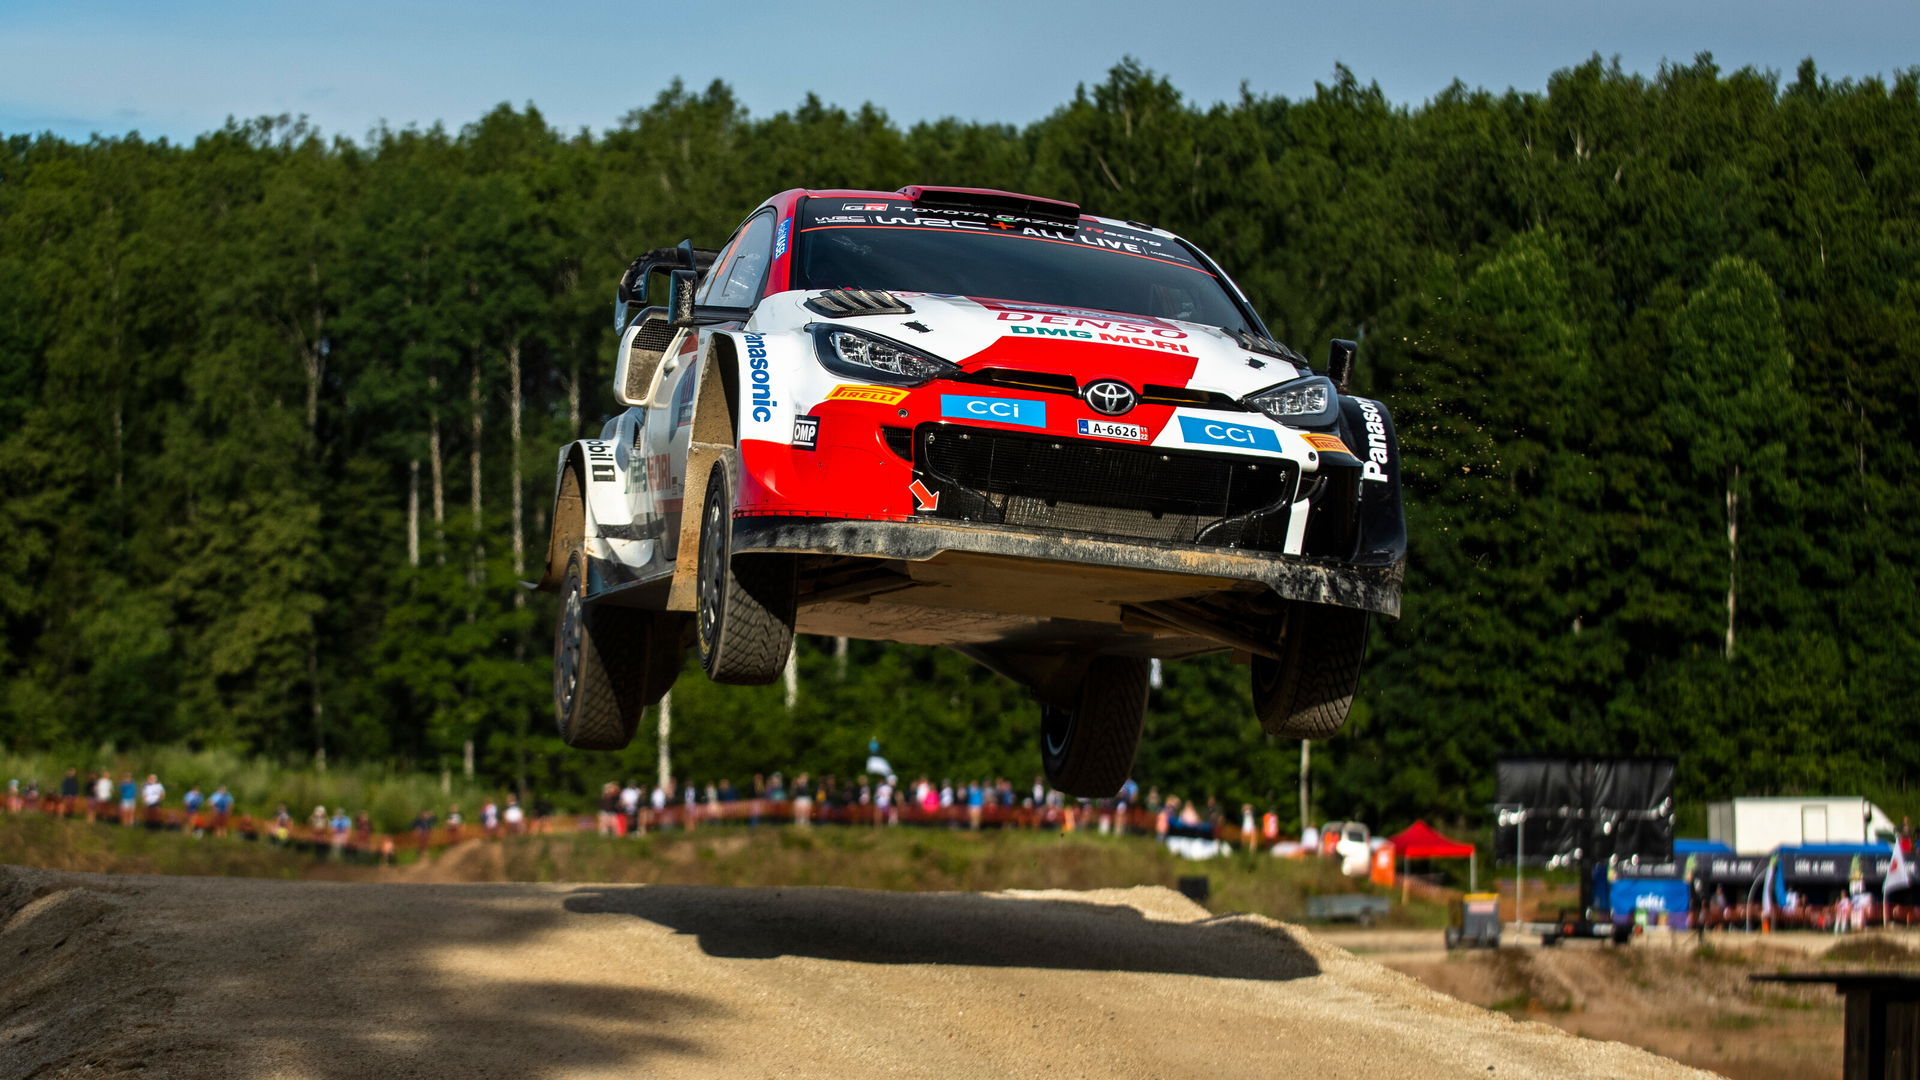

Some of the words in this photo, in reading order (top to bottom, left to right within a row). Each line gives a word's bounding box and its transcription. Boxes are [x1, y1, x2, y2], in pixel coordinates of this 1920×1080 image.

[895, 206, 989, 218] TOYOTA
[996, 214, 1080, 229] GAZOO
[1023, 227, 1074, 241] ALL
[1080, 235, 1141, 253] LIVE
[996, 311, 1189, 340] DENSO
[1010, 325, 1093, 339] DMG
[1099, 332, 1190, 354] MORI
[832, 386, 902, 402] PIRELLI
[794, 423, 816, 442] OMP
[1093, 423, 1138, 438] A-6626
